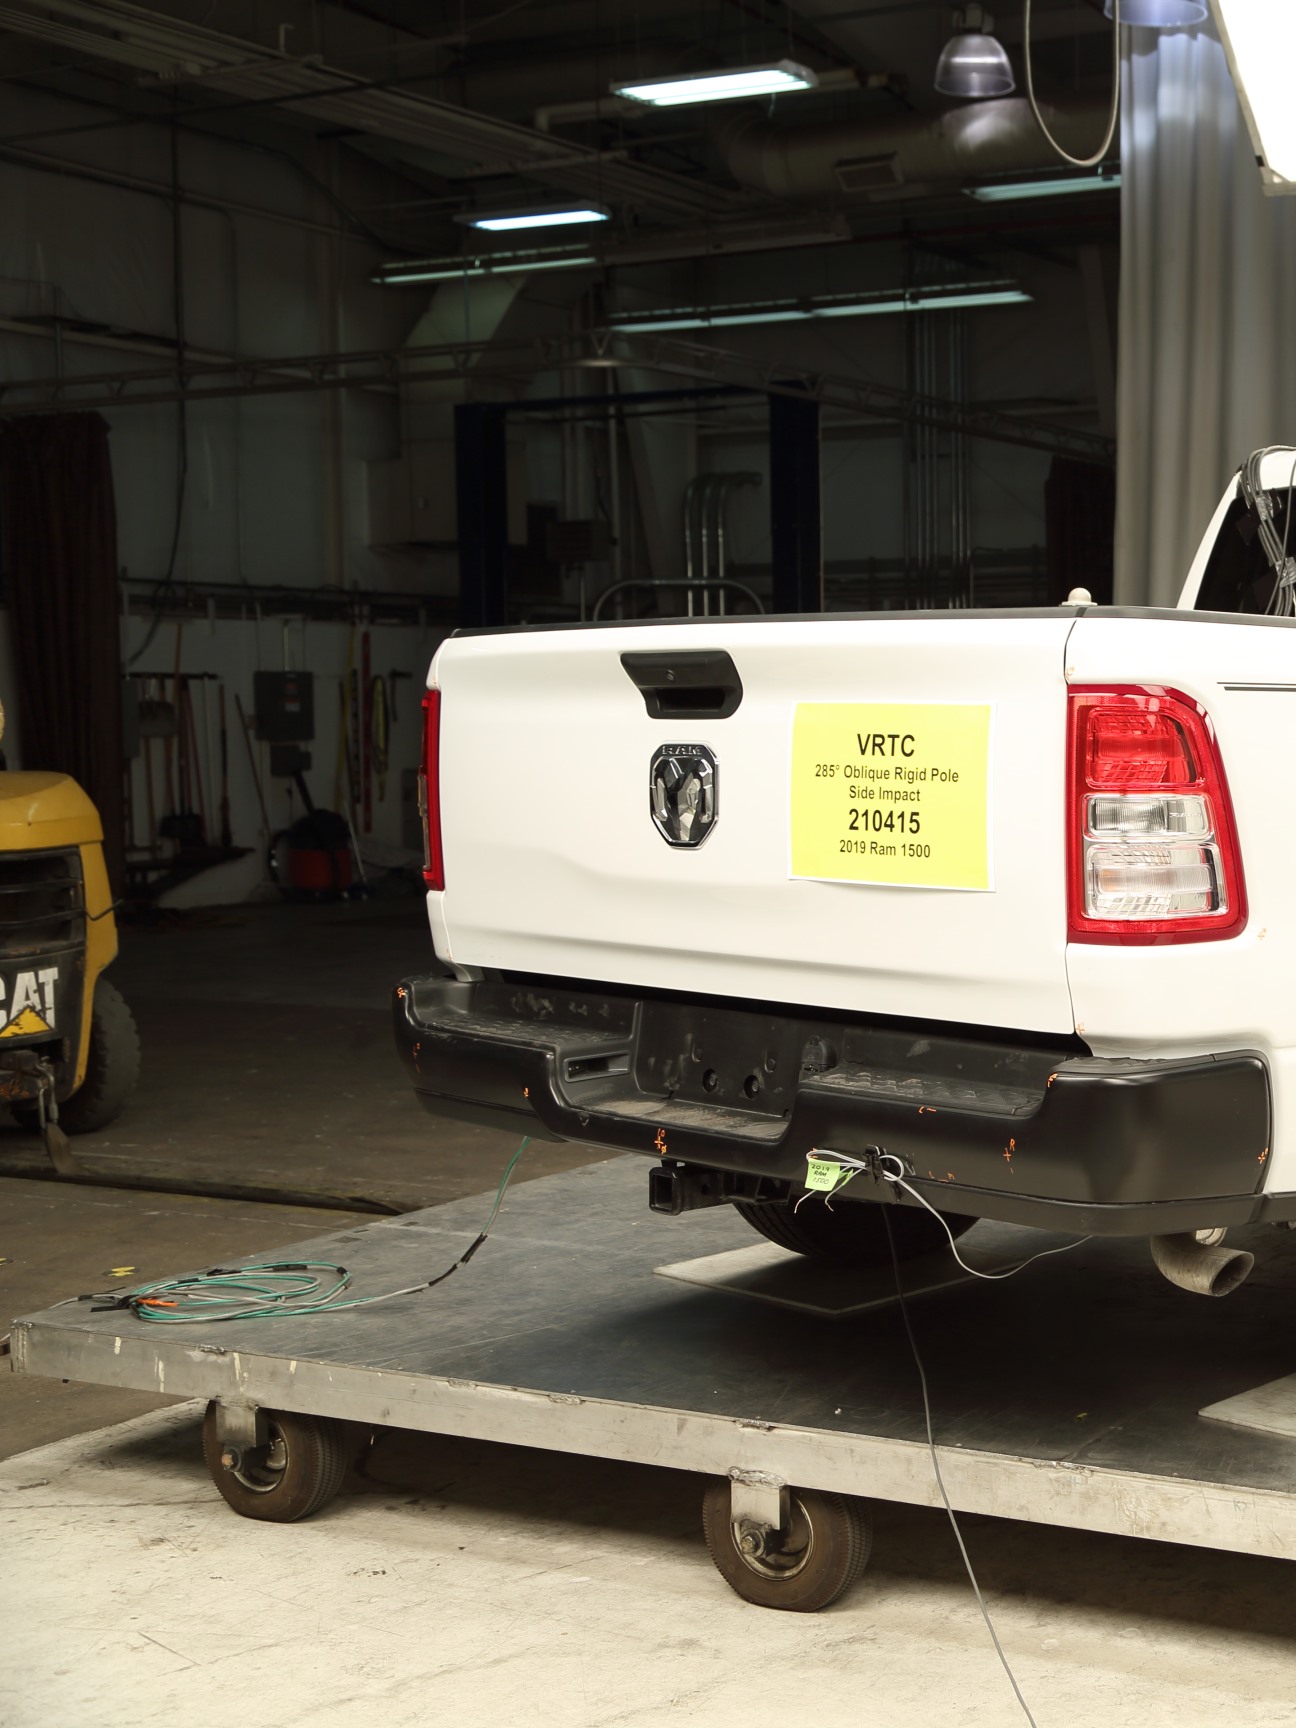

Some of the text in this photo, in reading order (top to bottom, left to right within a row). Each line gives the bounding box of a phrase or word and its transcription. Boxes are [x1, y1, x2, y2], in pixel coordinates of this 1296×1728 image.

[857, 733, 915, 757] VRTC
[815, 764, 959, 784] 285° Oblique Rigid Pole
[849, 785, 921, 803] Side Impact
[849, 809, 920, 834] 210415
[840, 839, 931, 858] 2019 Ram 1500
[812, 1164, 830, 1172] 2019
